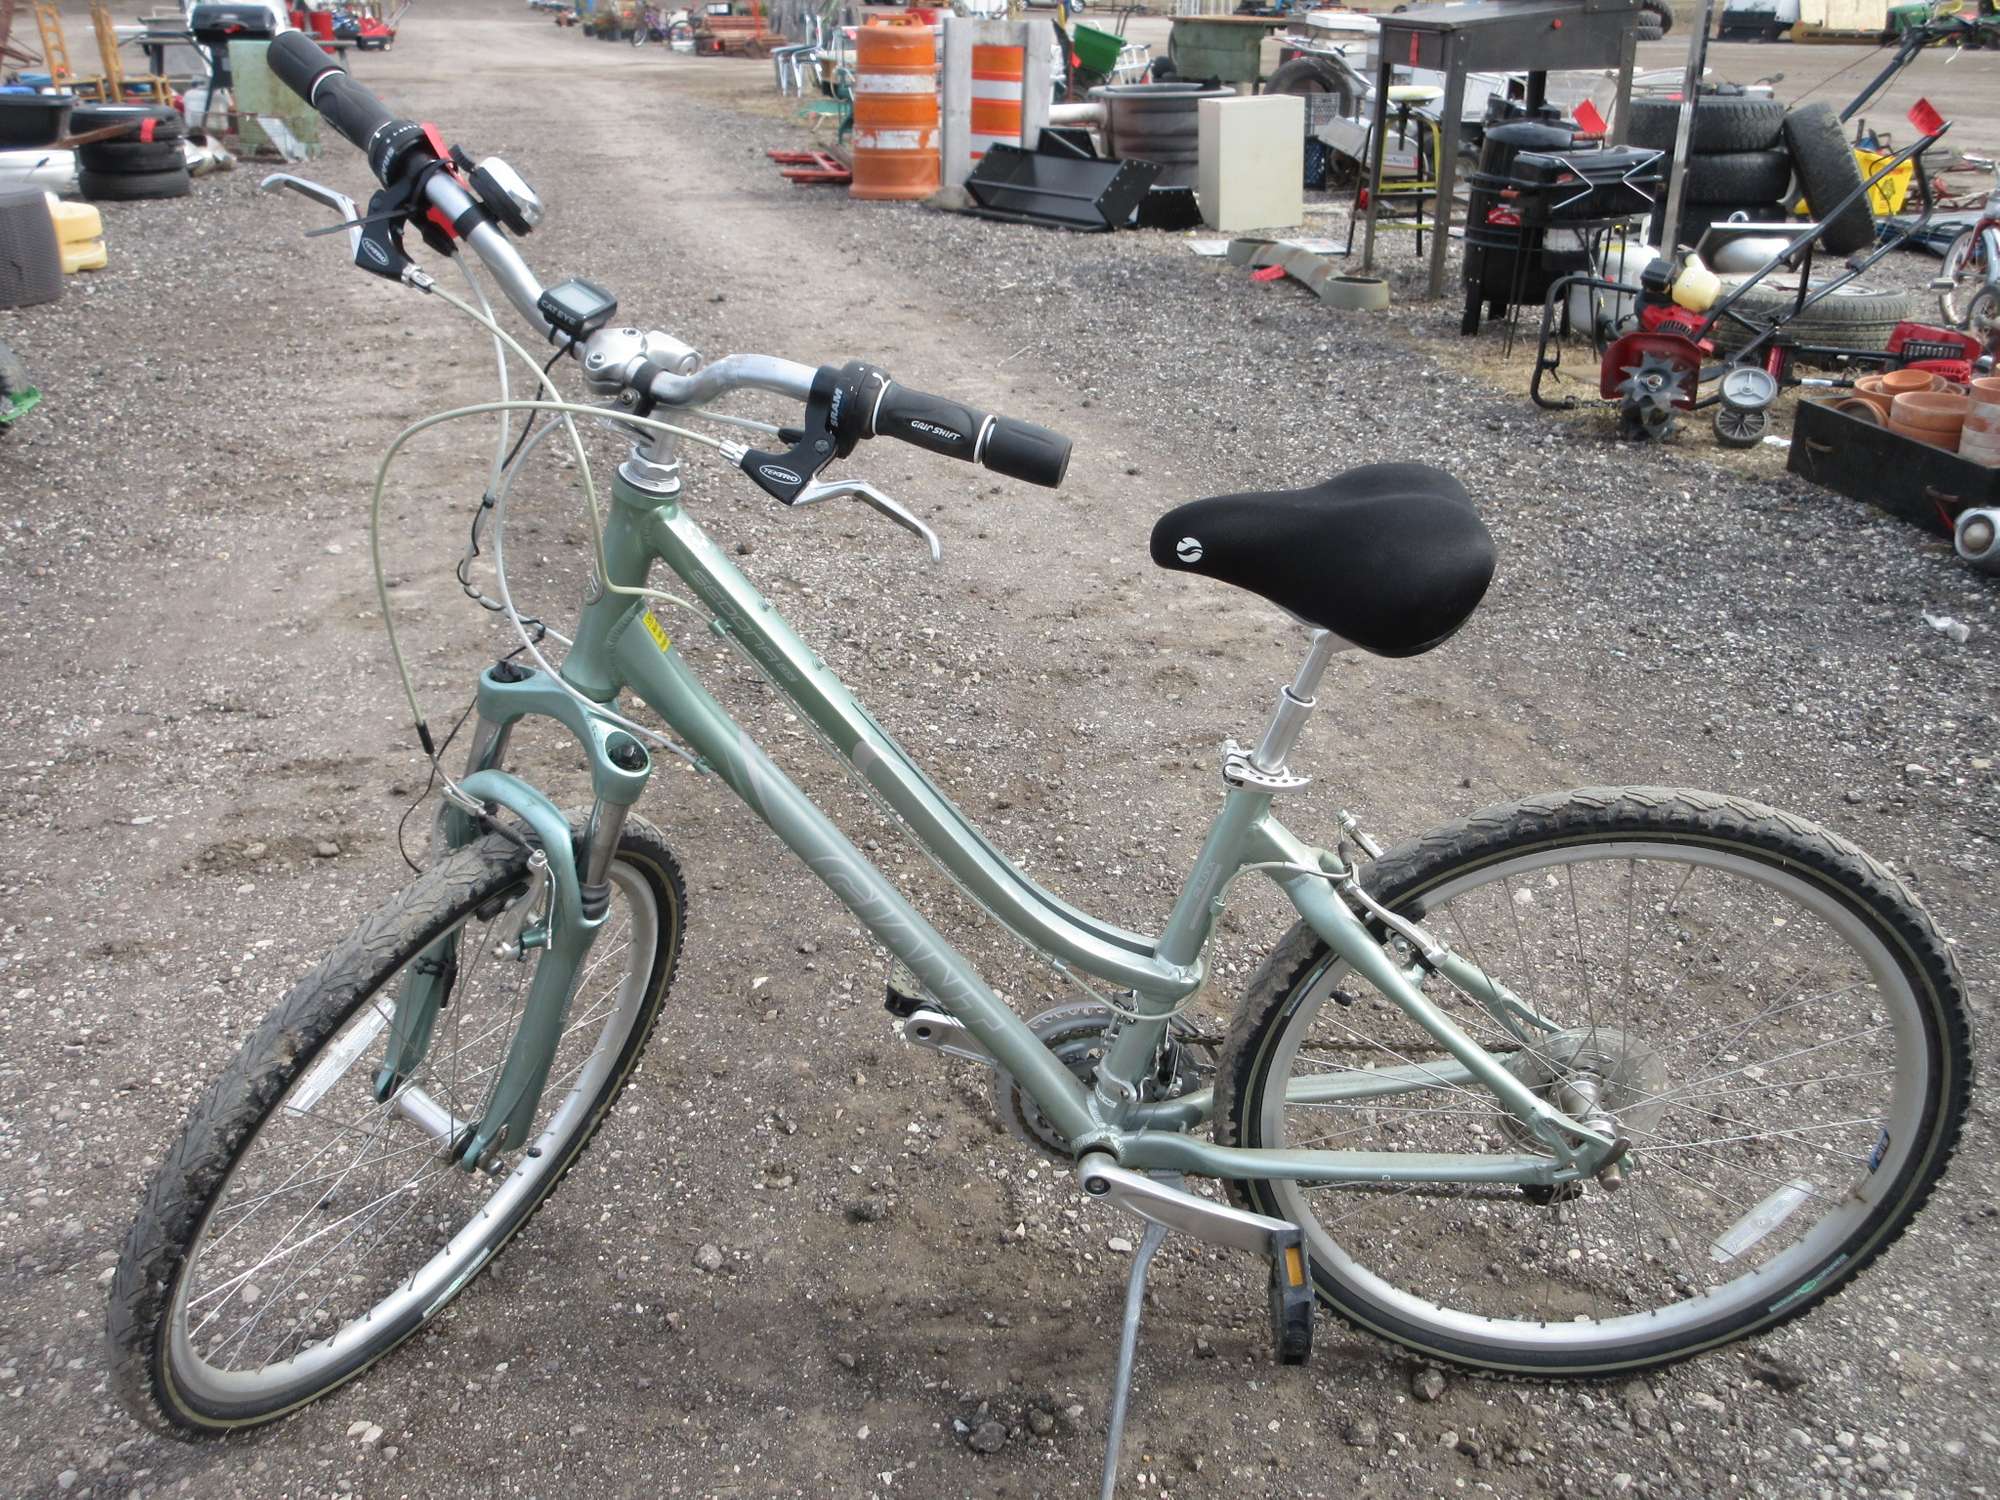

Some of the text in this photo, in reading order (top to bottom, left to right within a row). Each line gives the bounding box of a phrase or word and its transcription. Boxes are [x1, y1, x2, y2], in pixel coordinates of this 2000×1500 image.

[830, 386, 843, 428] SRAM
[932, 426, 961, 441] SHIFT
[763, 467, 798, 482] TEKTRO
